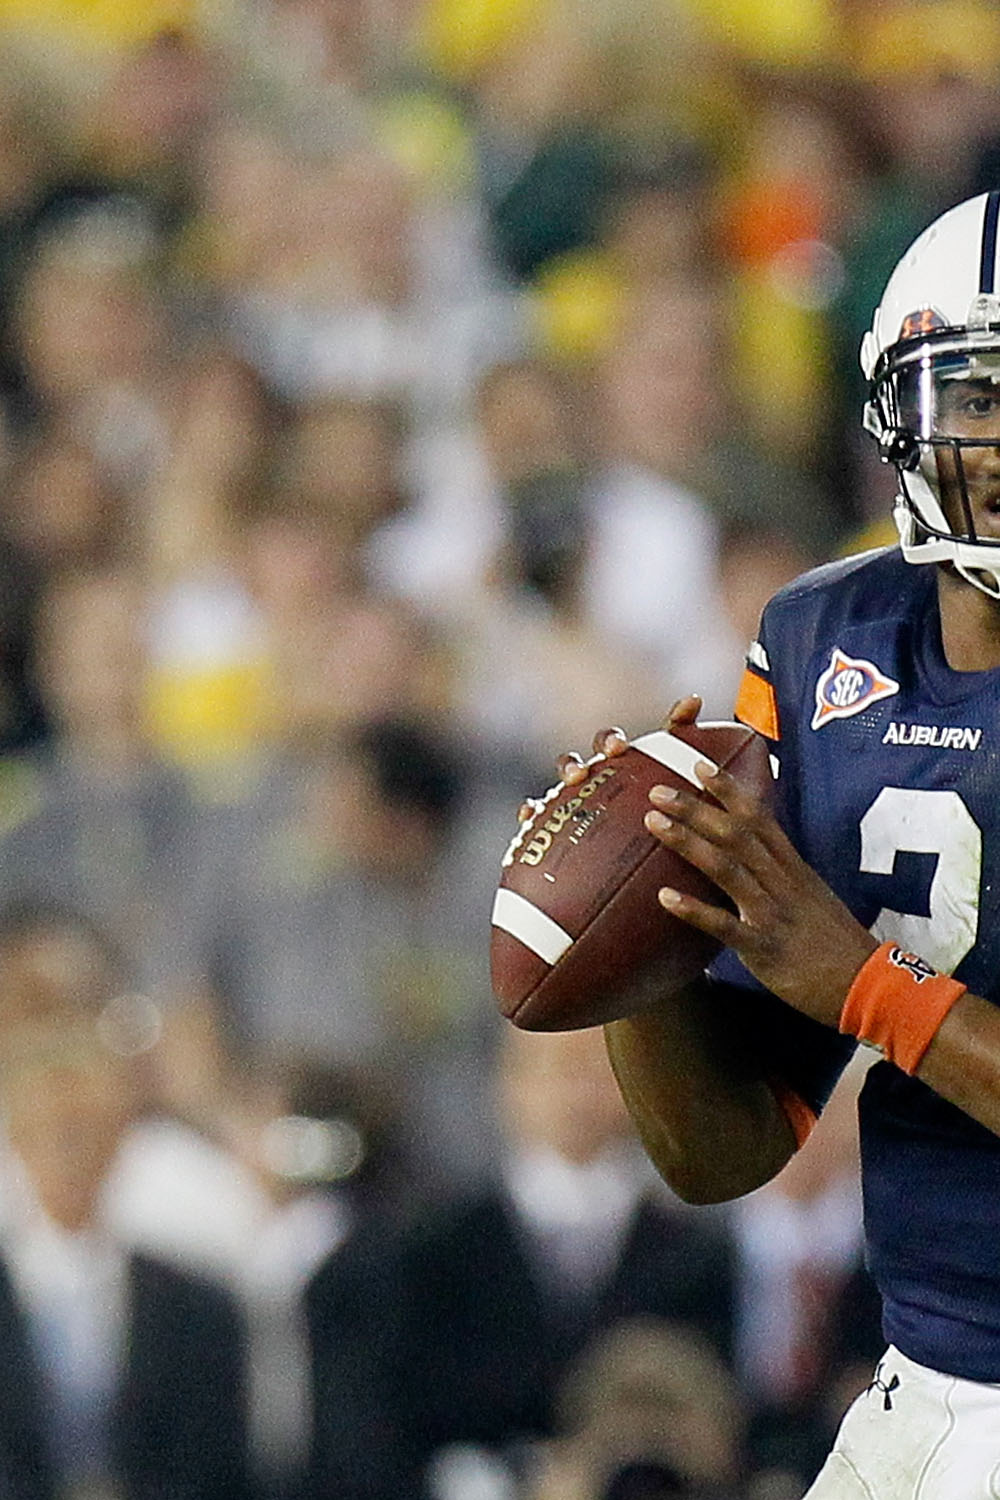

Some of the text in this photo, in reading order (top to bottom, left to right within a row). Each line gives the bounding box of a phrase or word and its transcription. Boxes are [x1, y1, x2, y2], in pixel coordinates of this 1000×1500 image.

[831, 669, 864, 706] SEC
[882, 722, 982, 751] AUBURN
[520, 767, 617, 866] Wilson
[858, 786, 982, 977] 2
